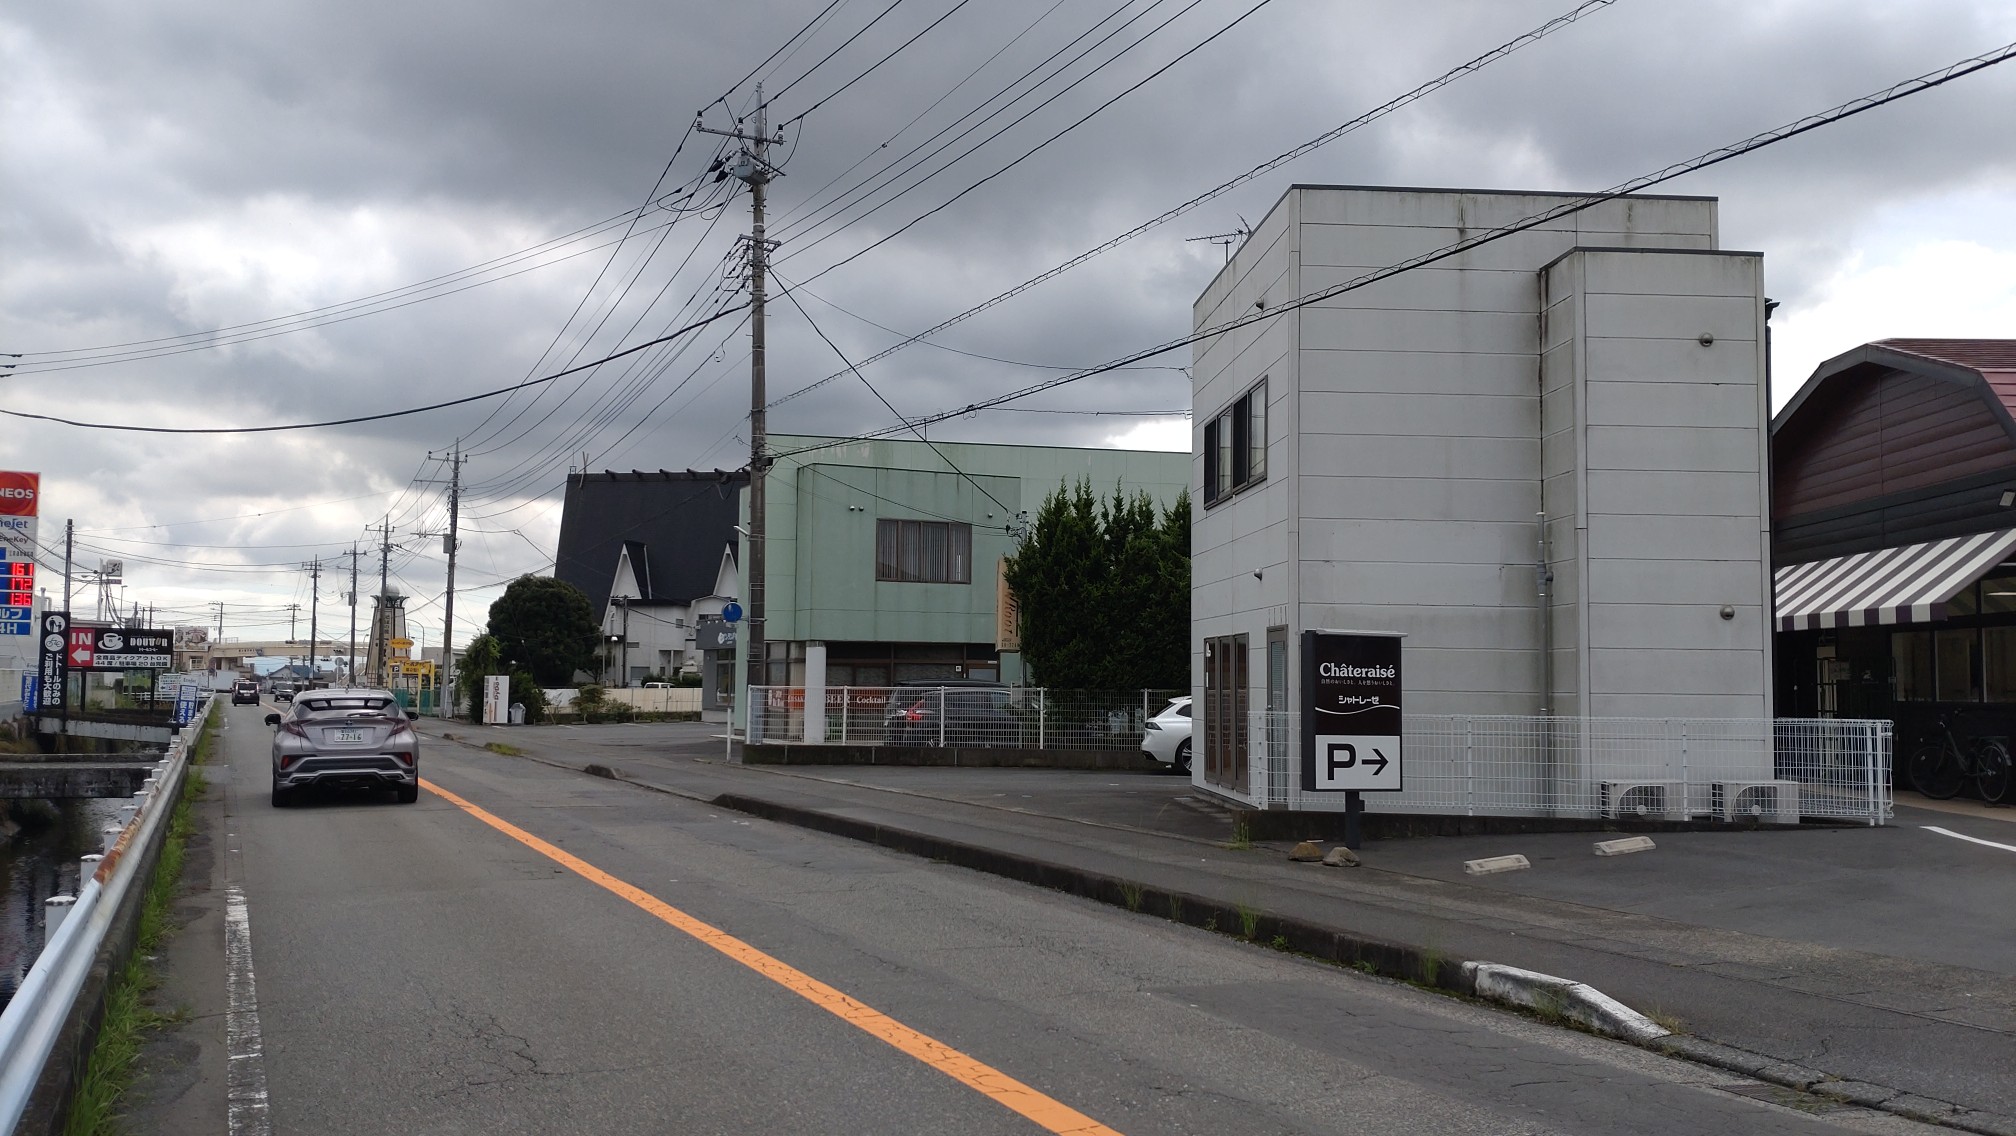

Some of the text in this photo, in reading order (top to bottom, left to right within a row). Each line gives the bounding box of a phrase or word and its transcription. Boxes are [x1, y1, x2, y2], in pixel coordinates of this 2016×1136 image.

[12, 563, 33, 576] 161
[12, 578, 32, 590] 172
[71, 633, 92, 645] IN
[1319, 662, 1396, 678] Châteraisé
[42, 653, 54, 706] ご利用も大歓迎
[52, 653, 63, 705] ドトールのみの
[856, 696, 886, 704] Cocktail
[1338, 695, 1380, 705] シャトレーゼ
[1327, 743, 1357, 781] P
